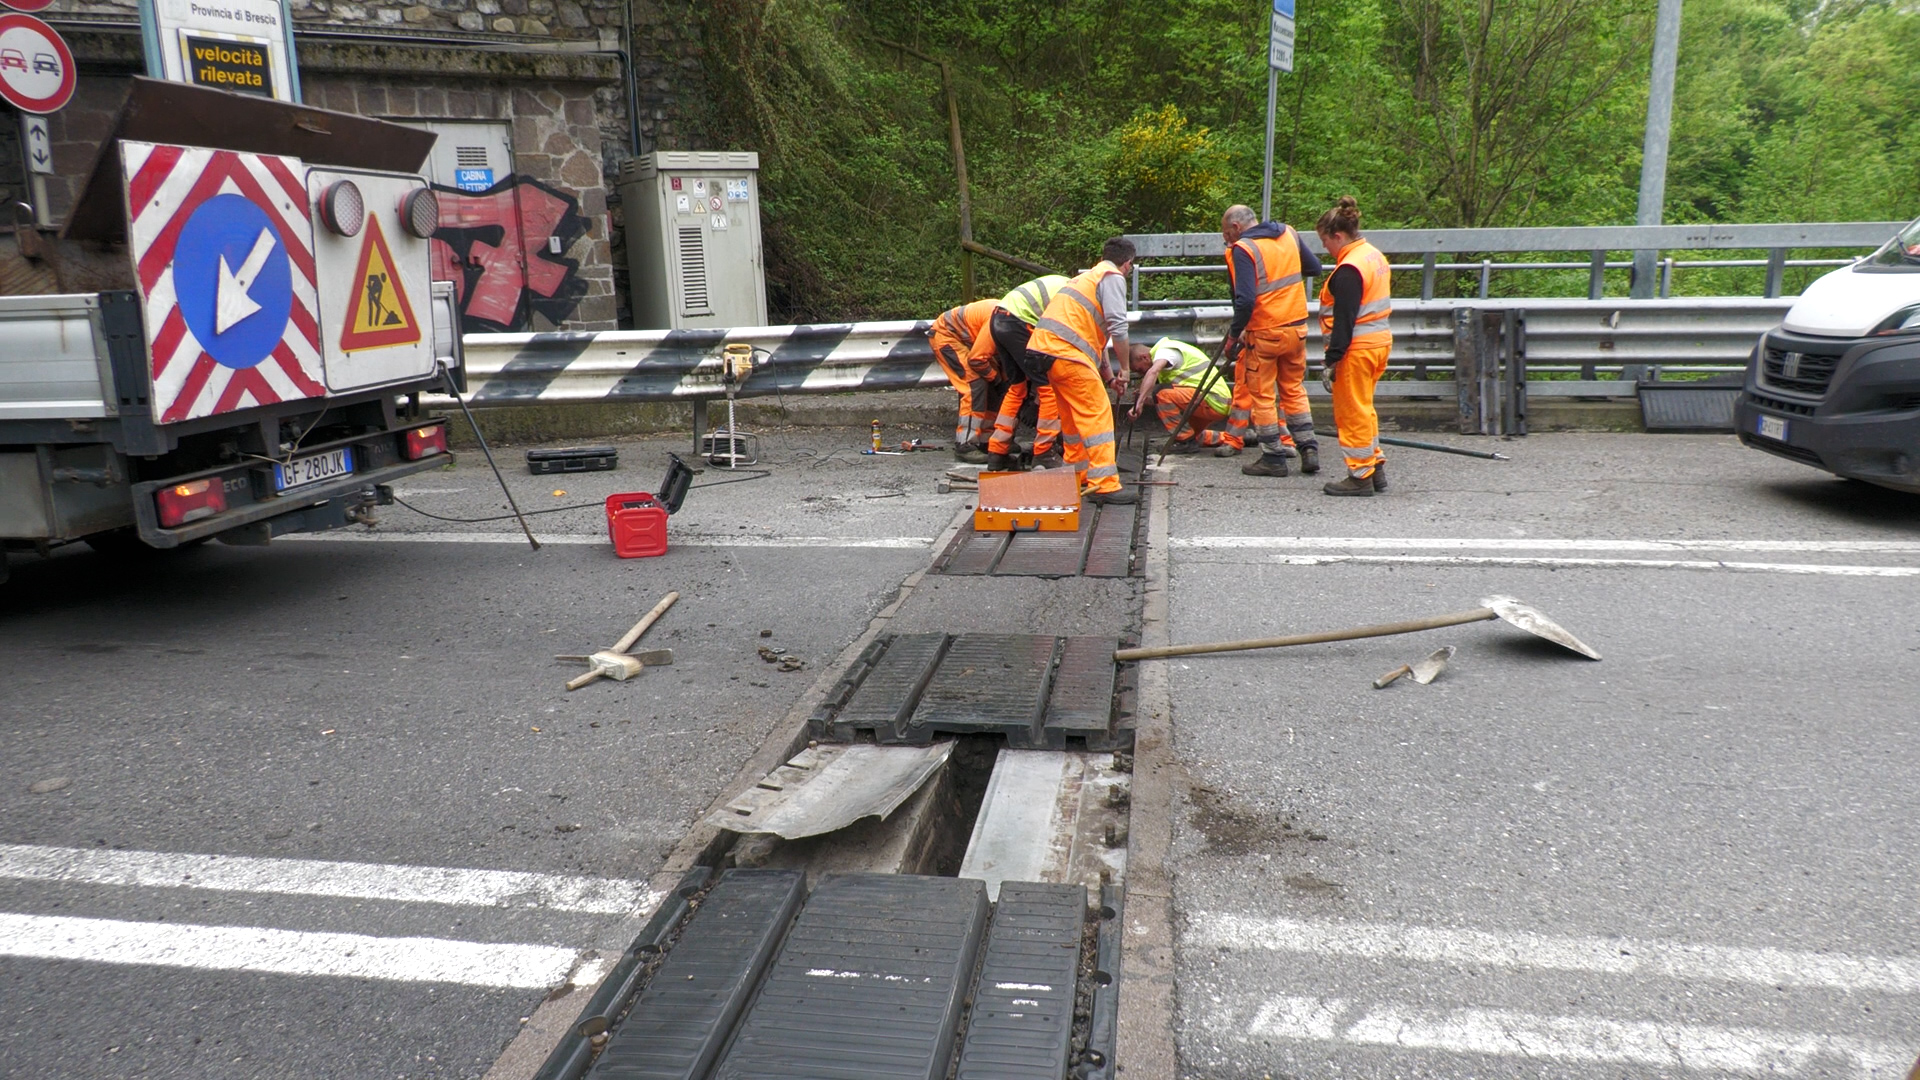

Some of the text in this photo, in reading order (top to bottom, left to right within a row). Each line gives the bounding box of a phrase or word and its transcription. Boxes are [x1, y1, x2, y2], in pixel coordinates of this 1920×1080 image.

[191, 4, 277, 25] Provincia di Brescia
[194, 46, 263, 66] velocità
[200, 66, 263, 86] rilevata
[461, 170, 486, 181] CABINA
[284, 451, 344, 485] GF 280JK
[223, 477, 247, 493] ECO
